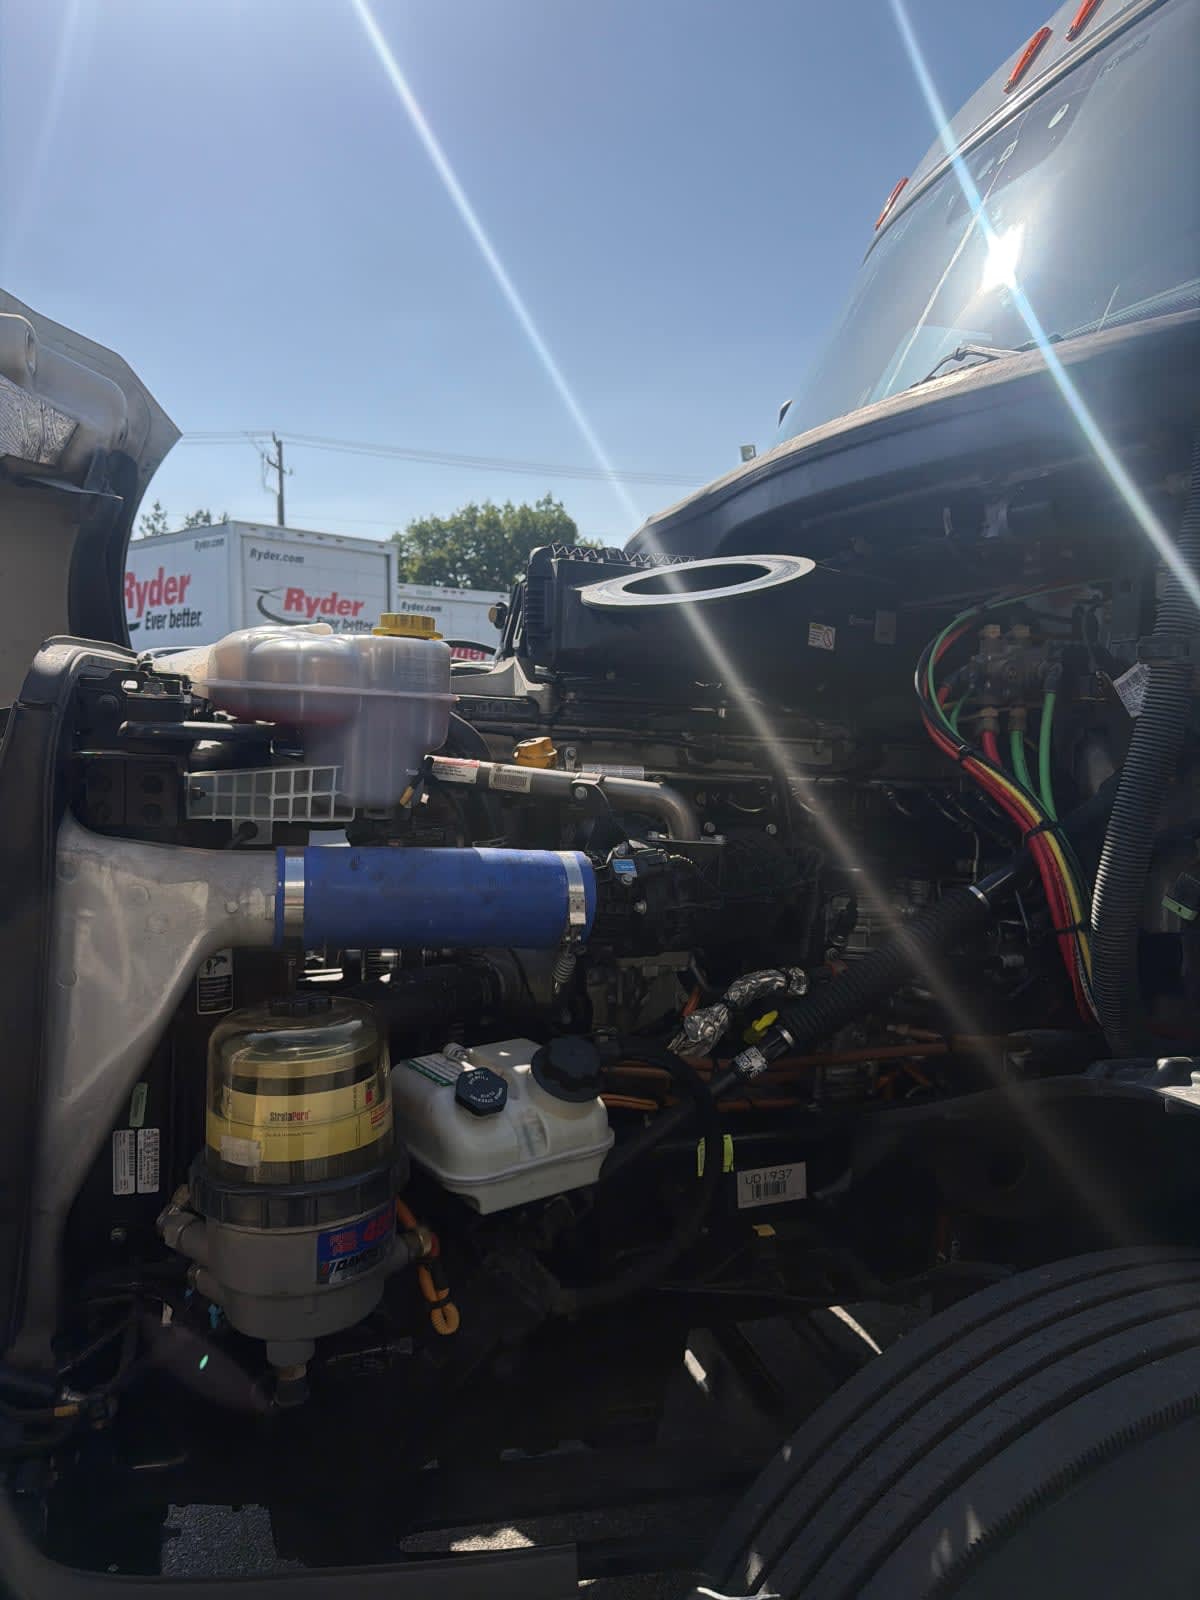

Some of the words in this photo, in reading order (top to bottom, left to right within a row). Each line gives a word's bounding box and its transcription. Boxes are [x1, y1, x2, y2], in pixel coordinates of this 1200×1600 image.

[249, 547, 305, 563] Ryder.com
[124, 567, 191, 618] Ryder
[283, 587, 365, 618] Ryder
[145, 611, 168, 630] Ever
[449, 647, 486, 661] der
